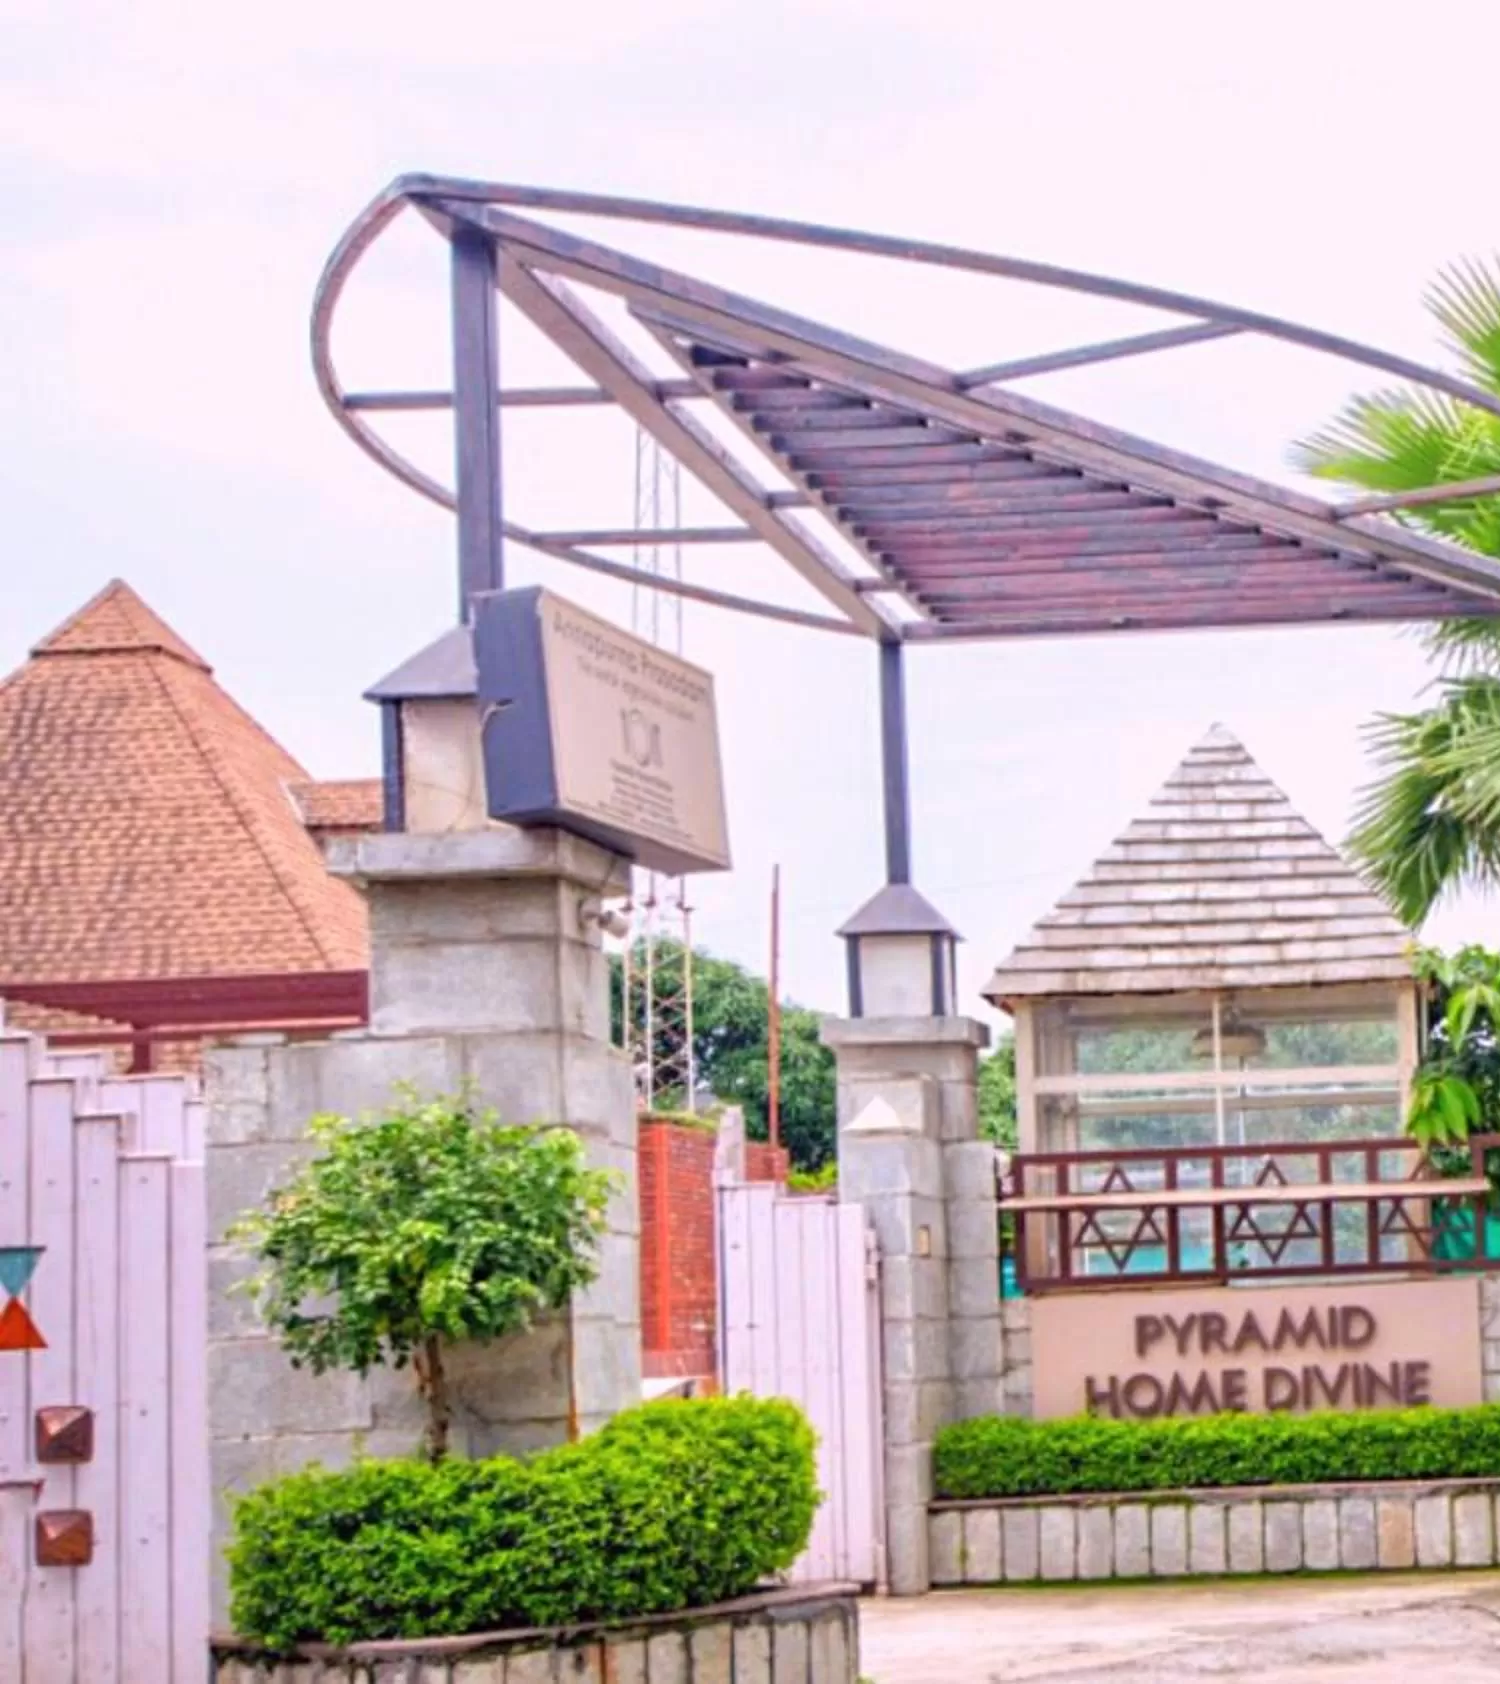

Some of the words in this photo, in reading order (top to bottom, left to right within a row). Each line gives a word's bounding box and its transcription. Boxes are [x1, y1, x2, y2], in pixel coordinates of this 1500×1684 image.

[1134, 1305, 1377, 1358] PYRAMID
[1084, 1368, 1248, 1419] HOME
[1263, 1360, 1431, 1411] DIVINE
